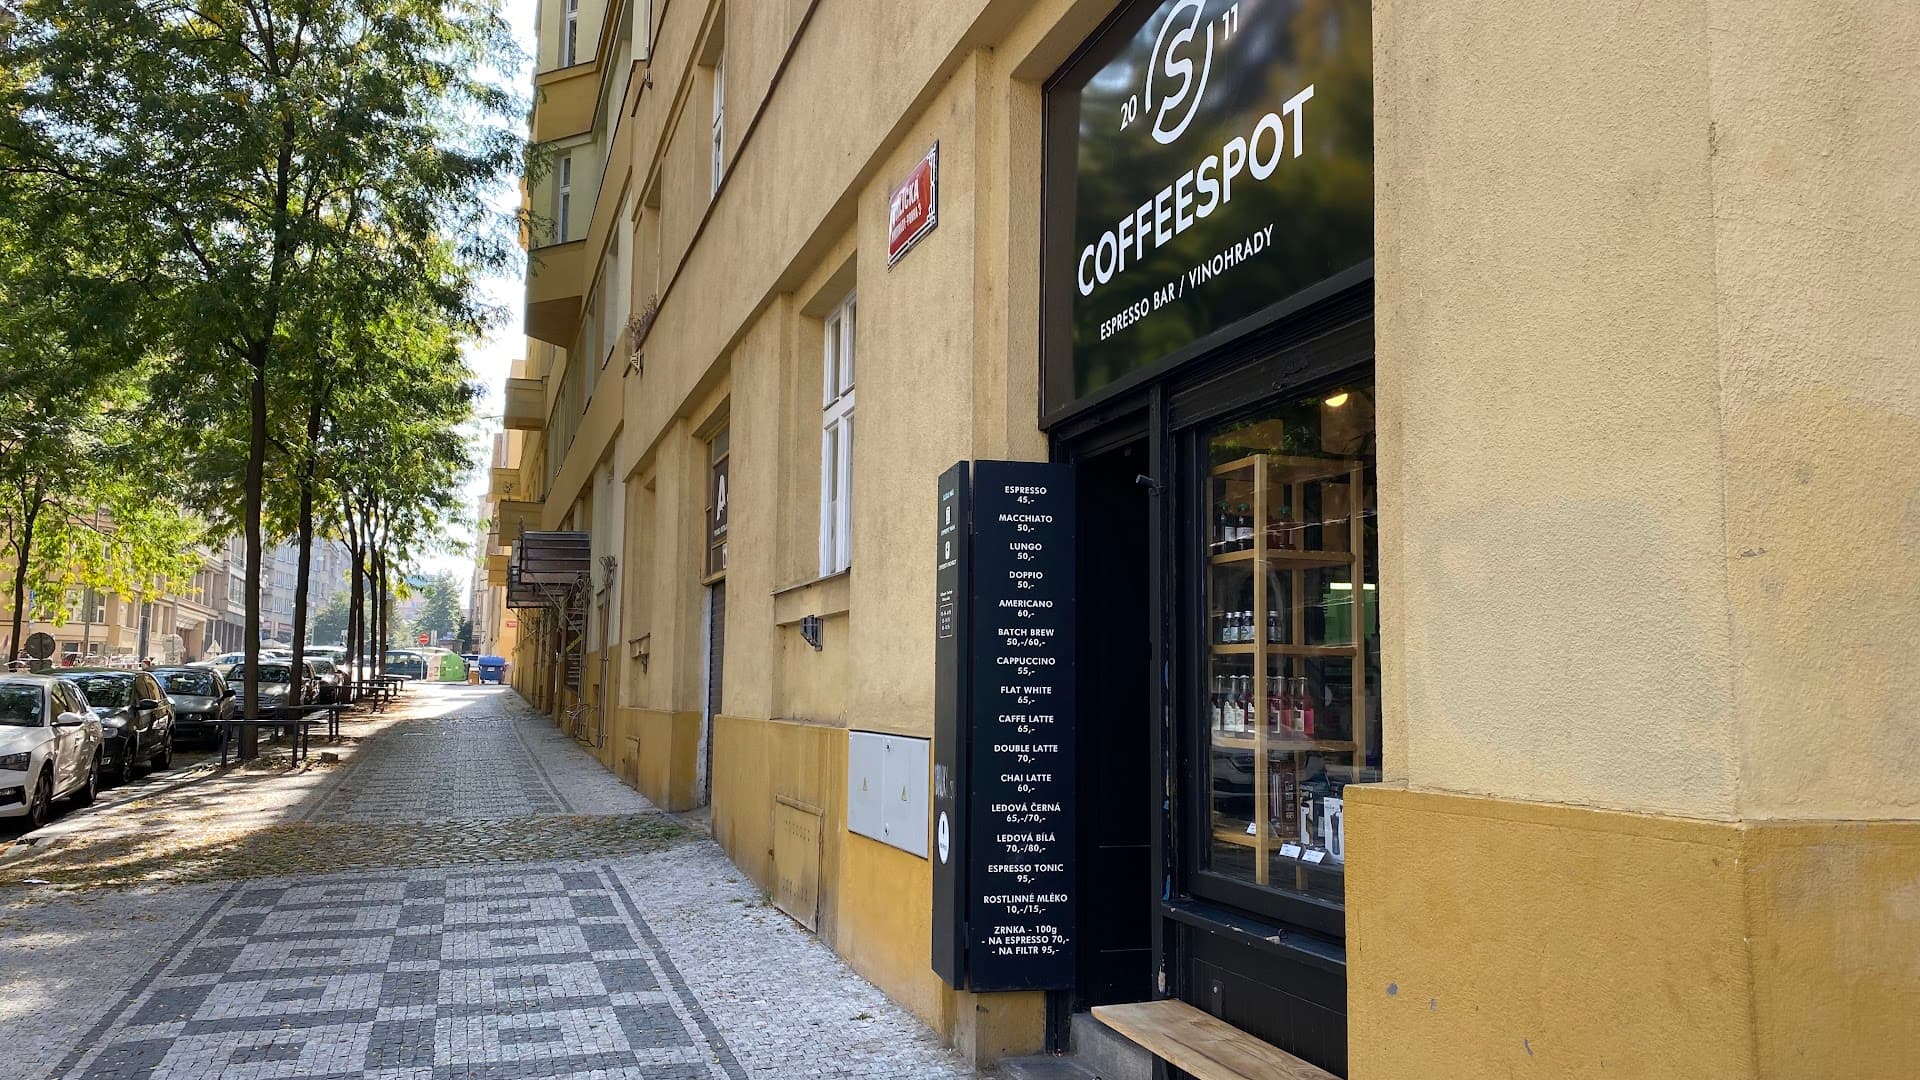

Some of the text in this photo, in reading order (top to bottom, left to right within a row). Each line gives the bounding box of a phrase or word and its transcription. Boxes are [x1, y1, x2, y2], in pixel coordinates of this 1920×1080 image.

[1120, 94, 1137, 131] 20
[1222, 3, 1239, 40] 11
[1077, 83, 1314, 296] COFFEESPOT
[1100, 223, 1274, 341] ESPRESSO BAR / VINOHRADY
[1005, 486, 1046, 494] ESPRESSO
[999, 514, 1052, 522] MACCHIATO
[1010, 571, 1043, 579] DOPPIO
[997, 657, 1055, 665] CAPPUCCINO
[1029, 715, 1053, 723] LATTE
[1001, 774, 1023, 782] CHAI
[992, 802, 1060, 812] LEDOVÁ ČERNÁ
[997, 832, 1055, 842] LEDOVÁ BÍLÁ
[988, 864, 1063, 872] ESPRESSO TONIC
[984, 893, 1067, 903] ROSTLINNÉ MLÉKO
[994, 926, 1025, 934] ZRNKA
[1036, 925, 1057, 934] 100g
[1005, 936, 1048, 944] ESPRESSO
[999, 947, 1013, 955] NA
[1016, 946, 1038, 954] FILTR
